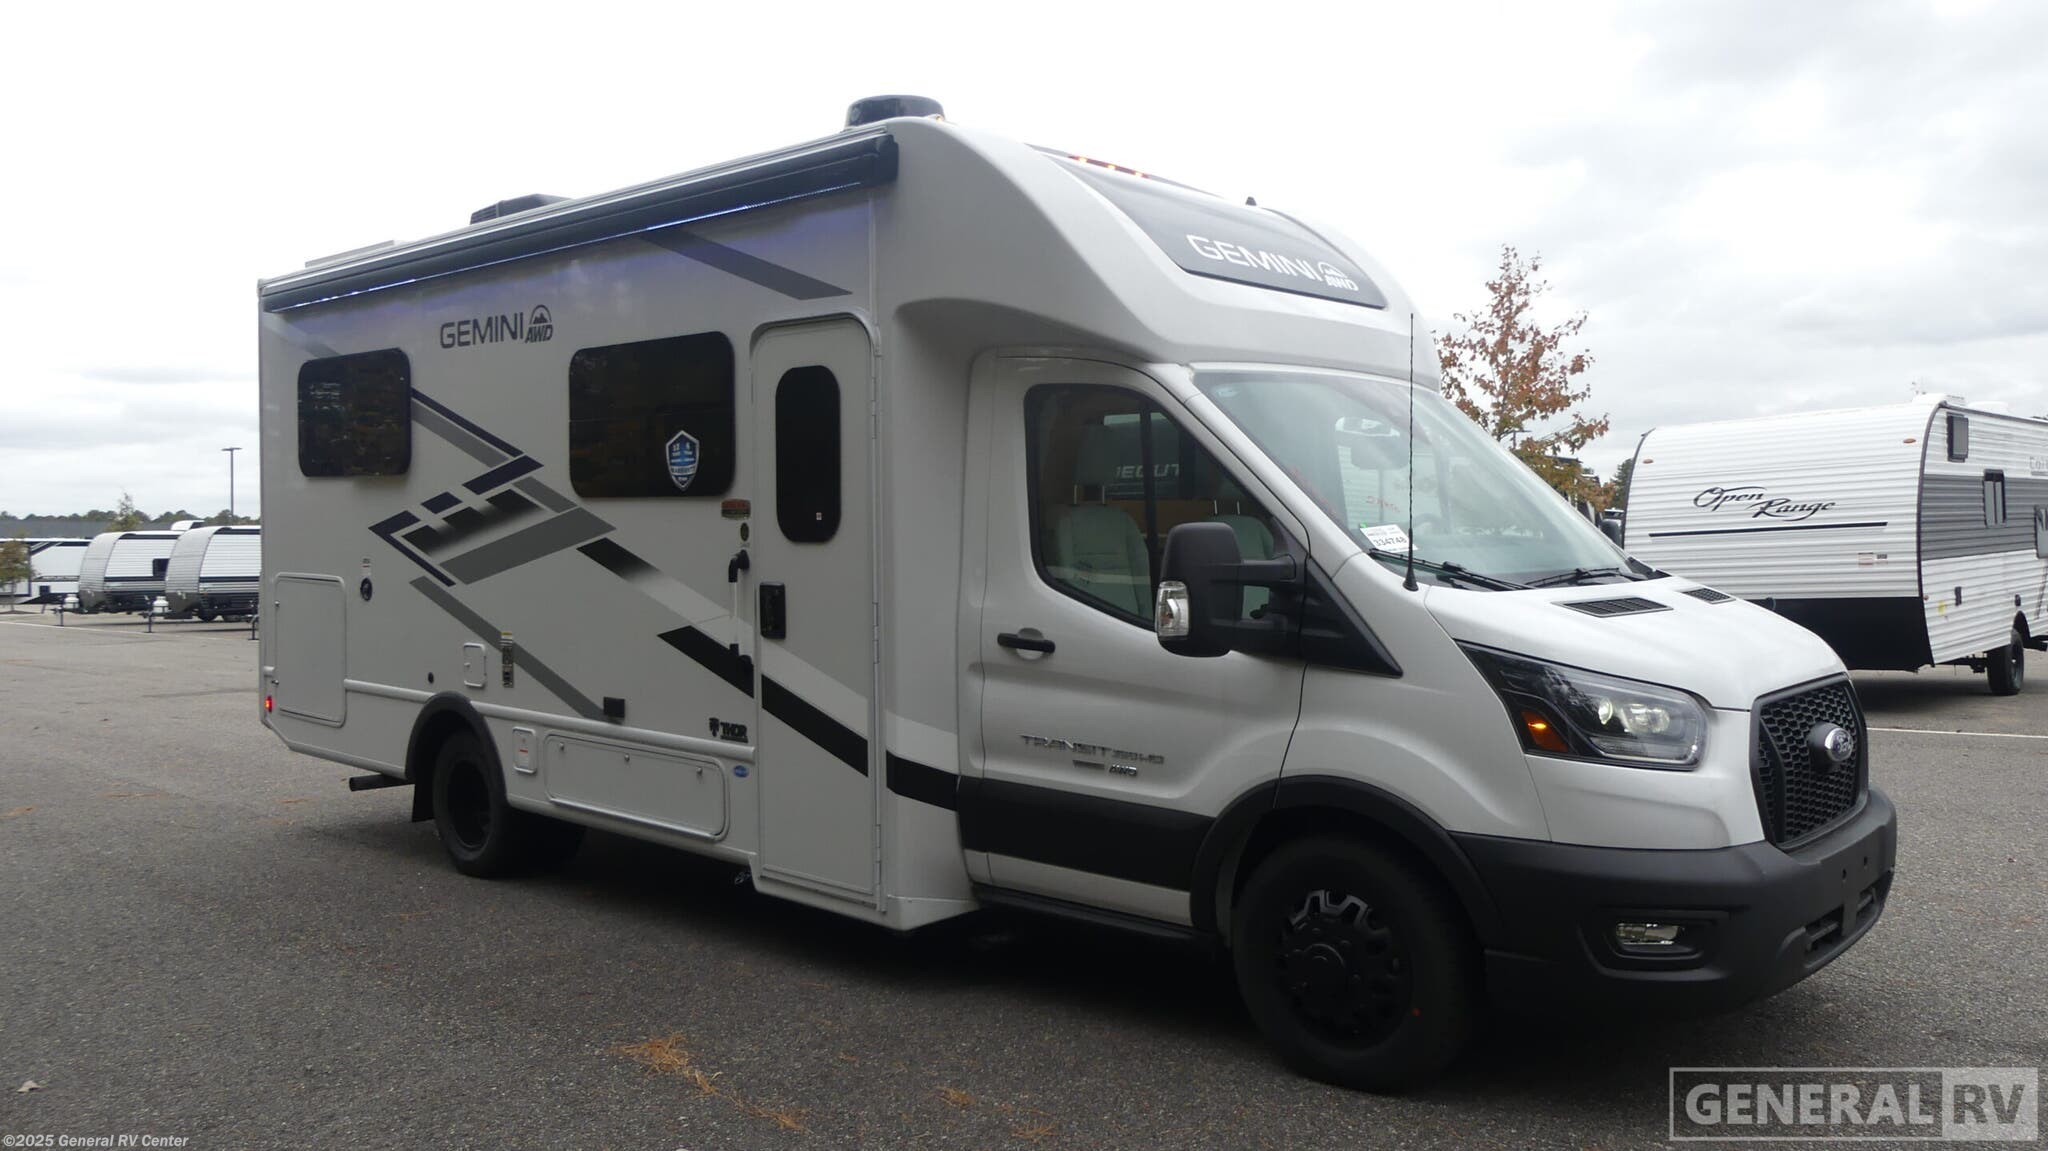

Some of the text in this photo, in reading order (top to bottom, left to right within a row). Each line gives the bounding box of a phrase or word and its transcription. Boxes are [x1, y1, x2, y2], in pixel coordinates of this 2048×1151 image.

[1186, 234, 1360, 292] GEMINI AWD
[440, 312, 554, 349] GEMINI AWD
[1693, 486, 1767, 512] Open
[1746, 498, 1836, 522] Range
[720, 722, 748, 738] THOR
[1020, 734, 1113, 757] TRANSIT
[1109, 764, 1138, 777] AWD
